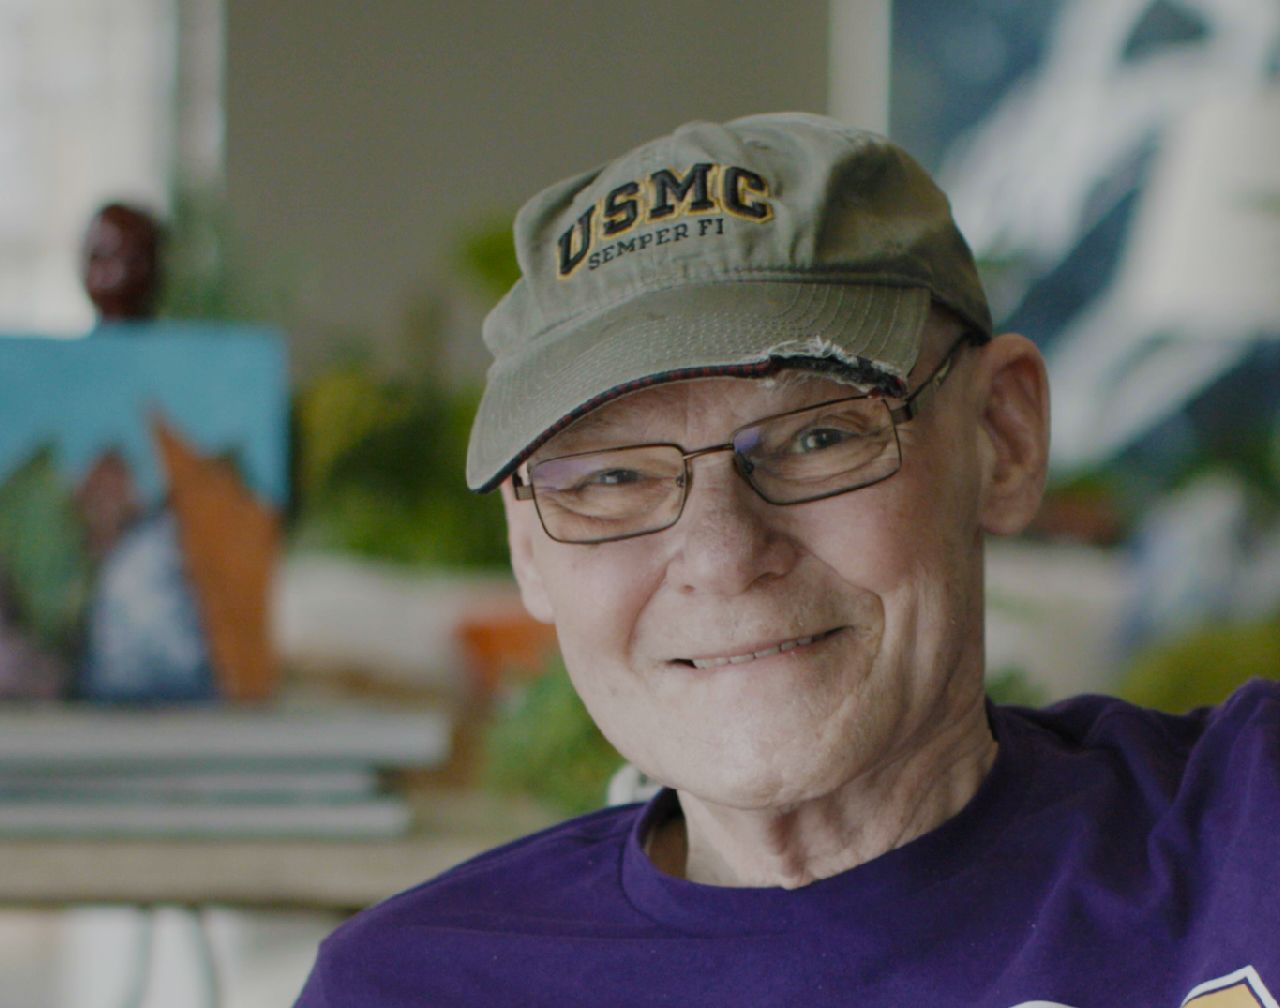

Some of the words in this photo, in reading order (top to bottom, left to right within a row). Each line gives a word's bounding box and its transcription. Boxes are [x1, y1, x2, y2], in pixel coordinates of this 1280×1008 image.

[557, 162, 773, 280] USMC
[588, 223, 688, 270] SEMPER
[698, 218, 724, 236] FI
